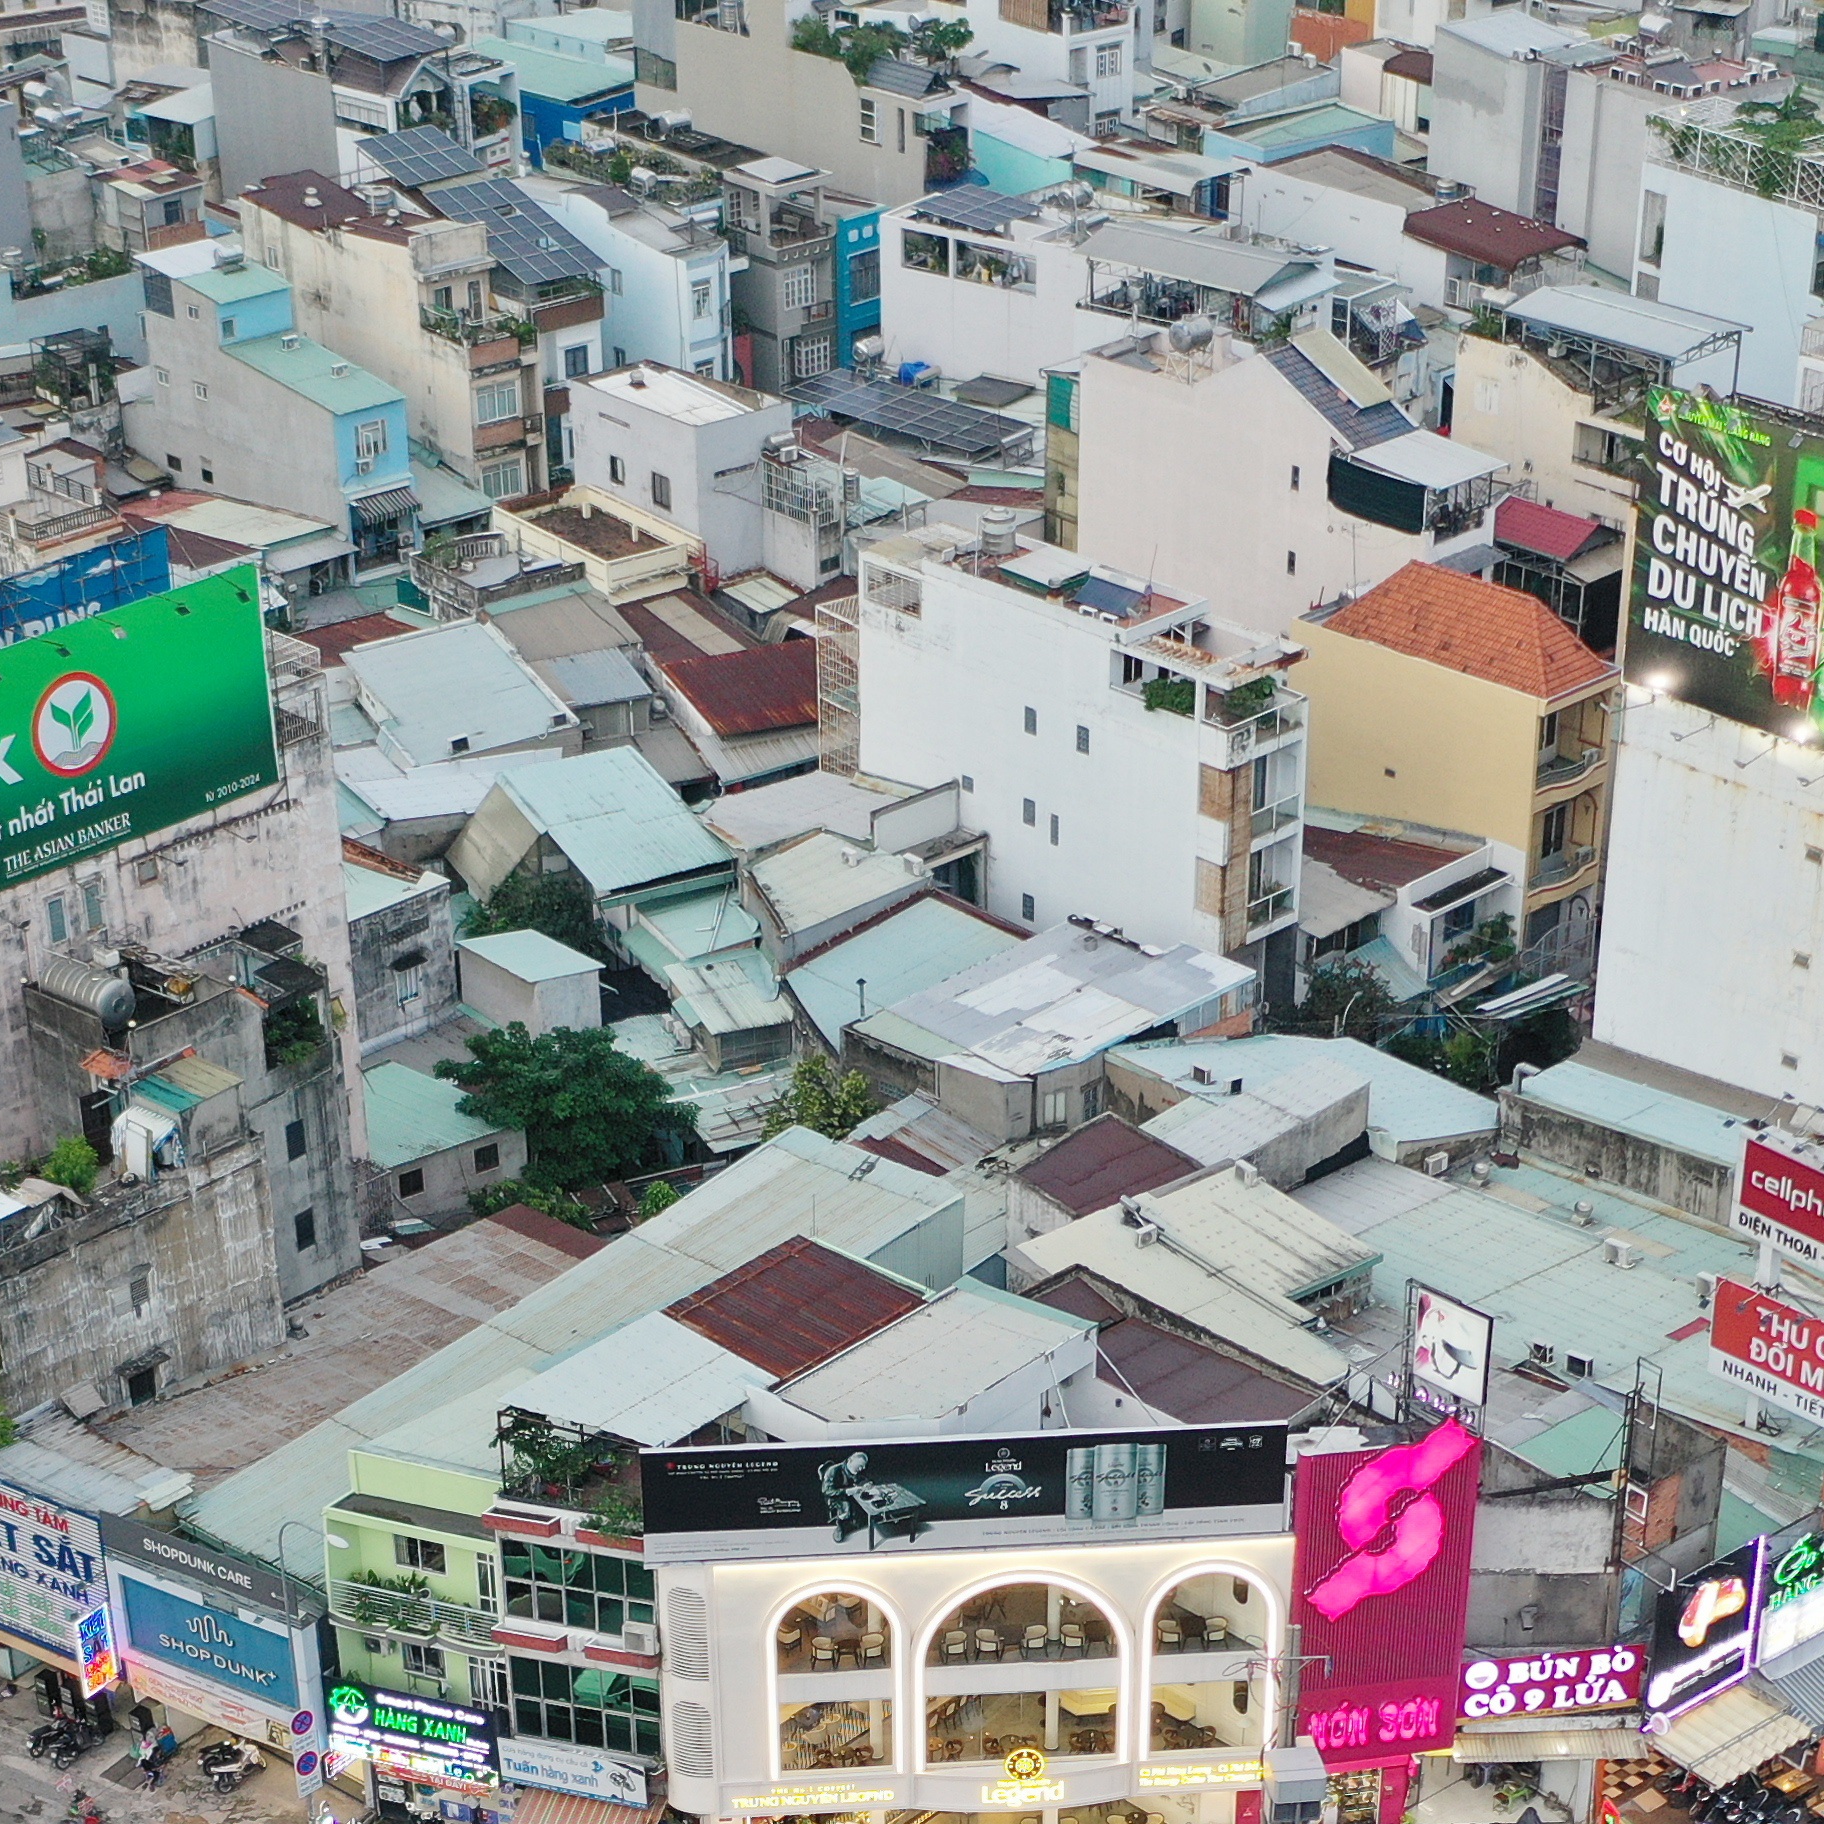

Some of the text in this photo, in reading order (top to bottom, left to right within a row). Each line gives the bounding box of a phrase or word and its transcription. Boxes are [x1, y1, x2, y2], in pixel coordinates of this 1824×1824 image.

[1659, 431, 1721, 493] CƠ HỘI
[1656, 462, 1755, 558] TRÚNG
[1653, 514, 1767, 602] CHUYẾN
[1647, 557, 1764, 638] DU LỊCH
[1644, 606, 1736, 657] HÀN QUỐC
[8, 799, 56, 837] nhất
[59, 782, 104, 818] Thái
[109, 770, 147, 801] Lan
[217, 772, 262, 798] 2010-2024
[4, 849, 34, 875] THE
[33, 833, 77, 862] ASIAN
[77, 811, 133, 846] BANKER
[1738, 1211, 1772, 1238] ĐIỆN
[1775, 1226, 1818, 1262] THOẠI
[1755, 1305, 1811, 1351] THU
[1723, 1359, 1778, 1397] NHANH
[1749, 1336, 1794, 1378] ĐỔI
[985, 1461, 1021, 1473] Legend
[33, 1505, 70, 1534] TÂM
[999, 1501, 1009, 1511] 8
[32, 1534, 96, 1584] SẮT
[143, 1538, 253, 1590] SHOPDUNK CARE
[35, 1569, 89, 1605] XANH
[1507, 1652, 1580, 1685] BÚN
[1589, 1645, 1636, 1676] BÒ
[1464, 1684, 1516, 1717] CÔ
[1523, 1688, 1545, 1711] 9
[374, 1706, 419, 1734] HÀNG
[422, 1717, 468, 1744] XANH
[1309, 1697, 1443, 1750] NÓN SƠN
[503, 1757, 599, 1788] Tuấn hàng xanh
[732, 1796, 779, 1809] TRUNG
[779, 1790, 839, 1809] NGUYÊN
[981, 1781, 1065, 1808] Legend
